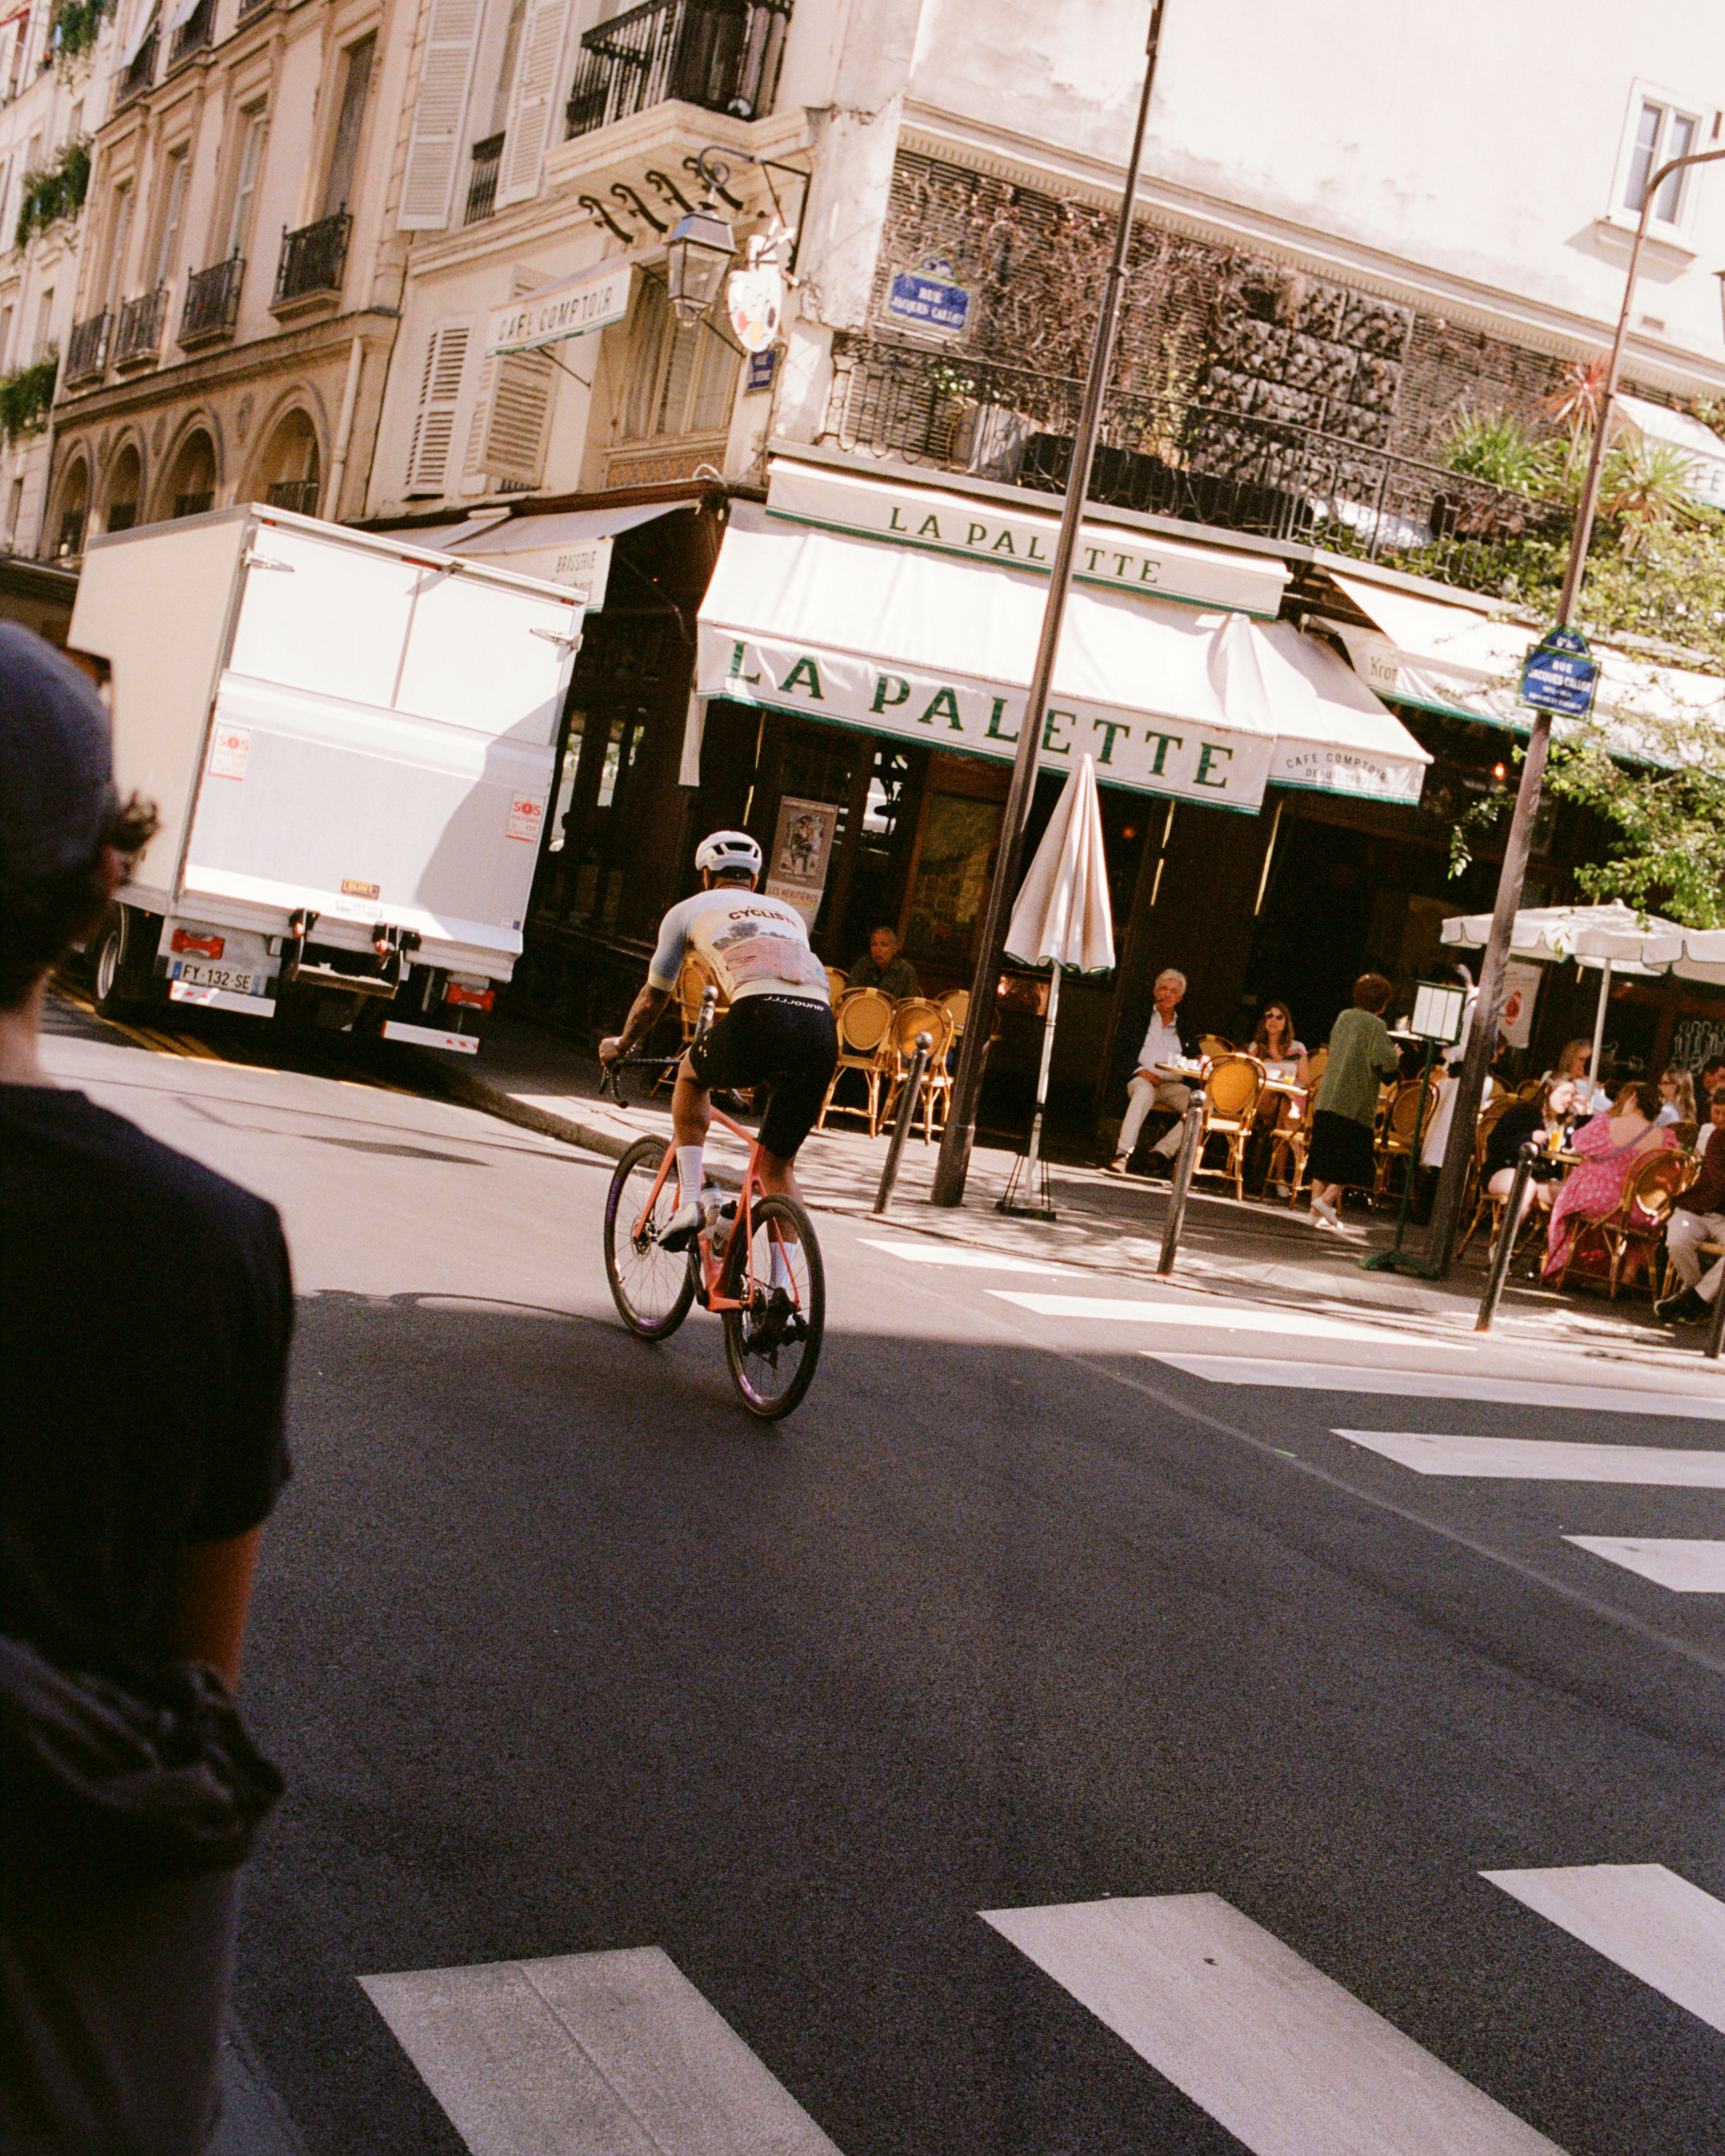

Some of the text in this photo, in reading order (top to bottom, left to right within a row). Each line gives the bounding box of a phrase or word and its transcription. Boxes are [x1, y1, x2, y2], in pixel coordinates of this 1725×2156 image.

[540, 287, 612, 331] COMPTOIR
[918, 287, 942, 303] RUE
[889, 507, 1160, 584] LA PALTTE
[1552, 660, 1573, 674] RUE
[726, 640, 1233, 789] LA PALETTE
[513, 801, 541, 816] SOS
